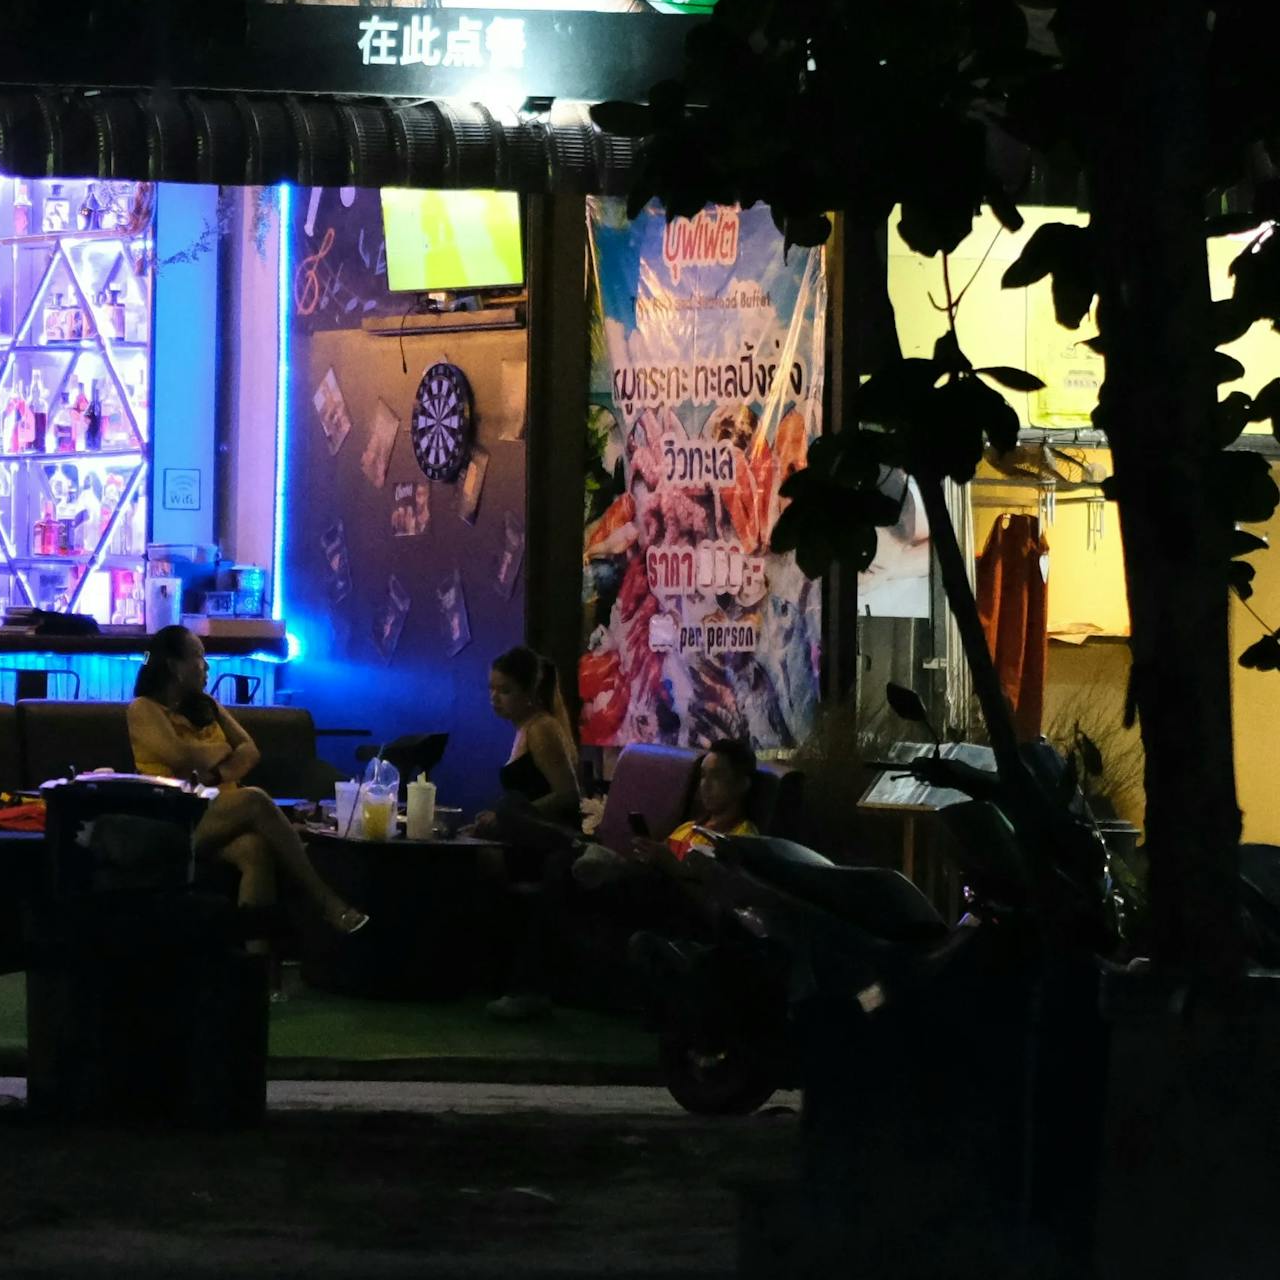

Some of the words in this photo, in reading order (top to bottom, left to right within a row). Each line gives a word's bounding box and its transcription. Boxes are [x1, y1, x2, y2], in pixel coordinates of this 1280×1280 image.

[694, 338, 803, 401] ทะเลปิ้งย่ง
[648, 552, 694, 589] ราคา
[680, 626, 702, 654] per
[706, 625, 754, 655] person
